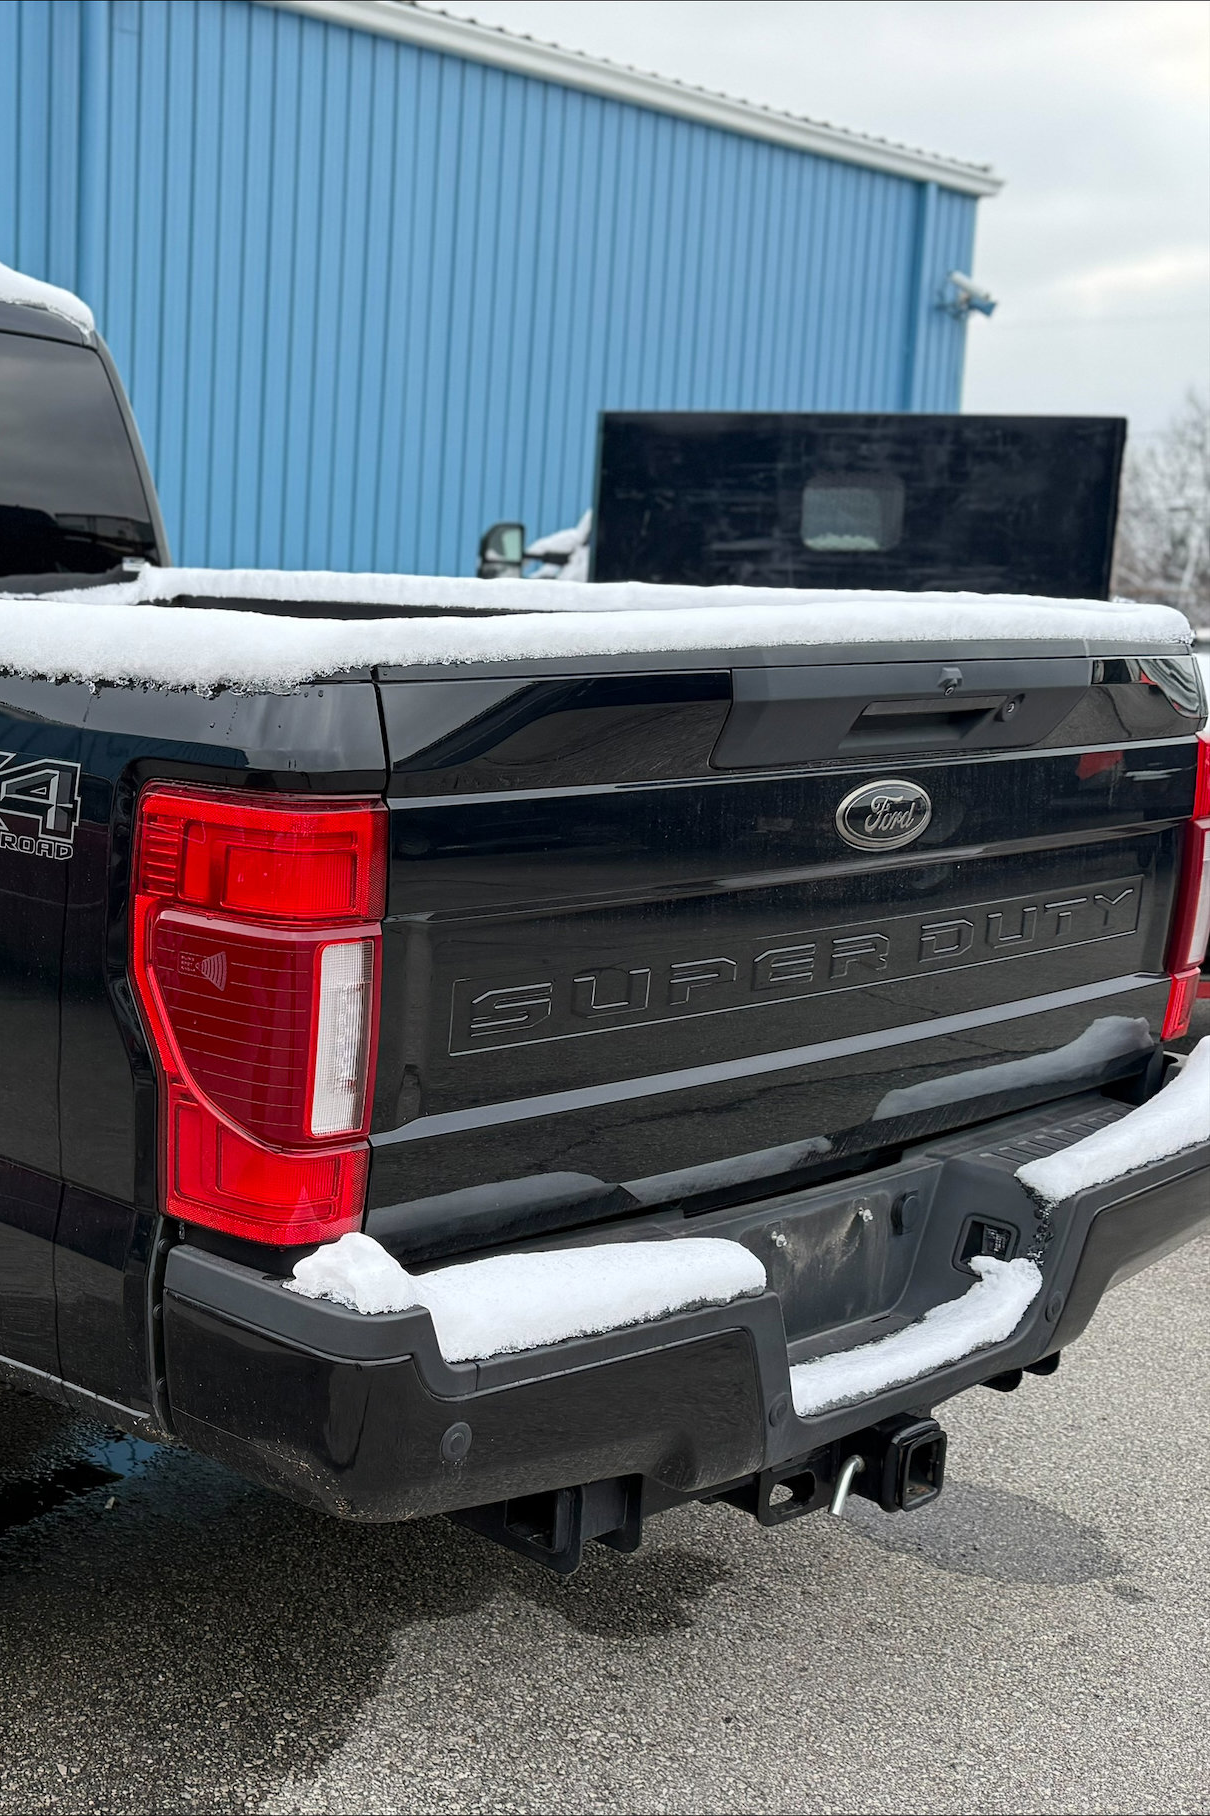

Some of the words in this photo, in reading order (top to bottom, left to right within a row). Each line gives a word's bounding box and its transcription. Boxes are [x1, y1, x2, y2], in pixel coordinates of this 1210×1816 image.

[864, 795, 916, 834] Ford
[0, 832, 74, 860] ROAD
[470, 932, 890, 1037] SUPER
[918, 889, 1133, 963] DUTY
